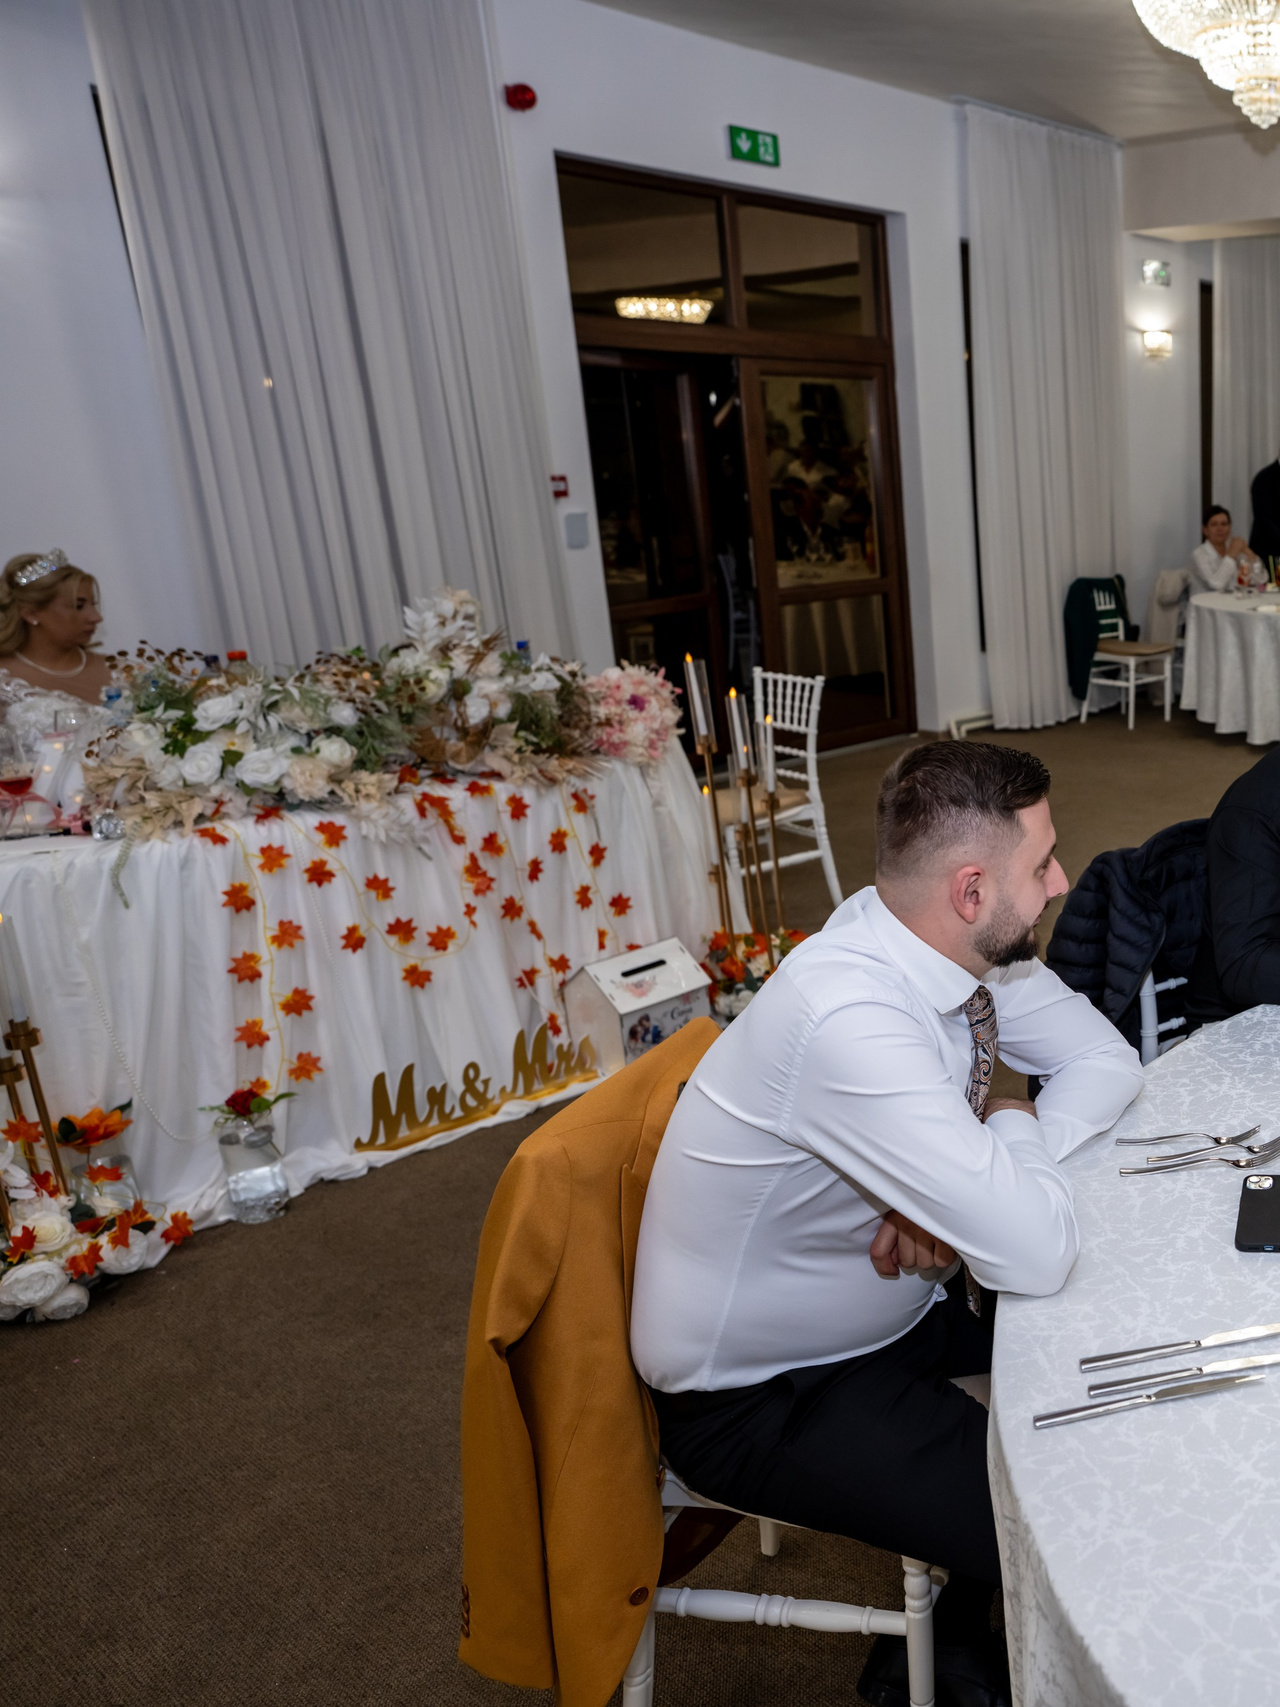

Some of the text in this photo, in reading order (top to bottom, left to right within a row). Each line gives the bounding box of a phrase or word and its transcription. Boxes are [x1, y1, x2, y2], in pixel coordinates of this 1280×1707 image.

[354, 1022, 597, 1151] Mr & Mrs
